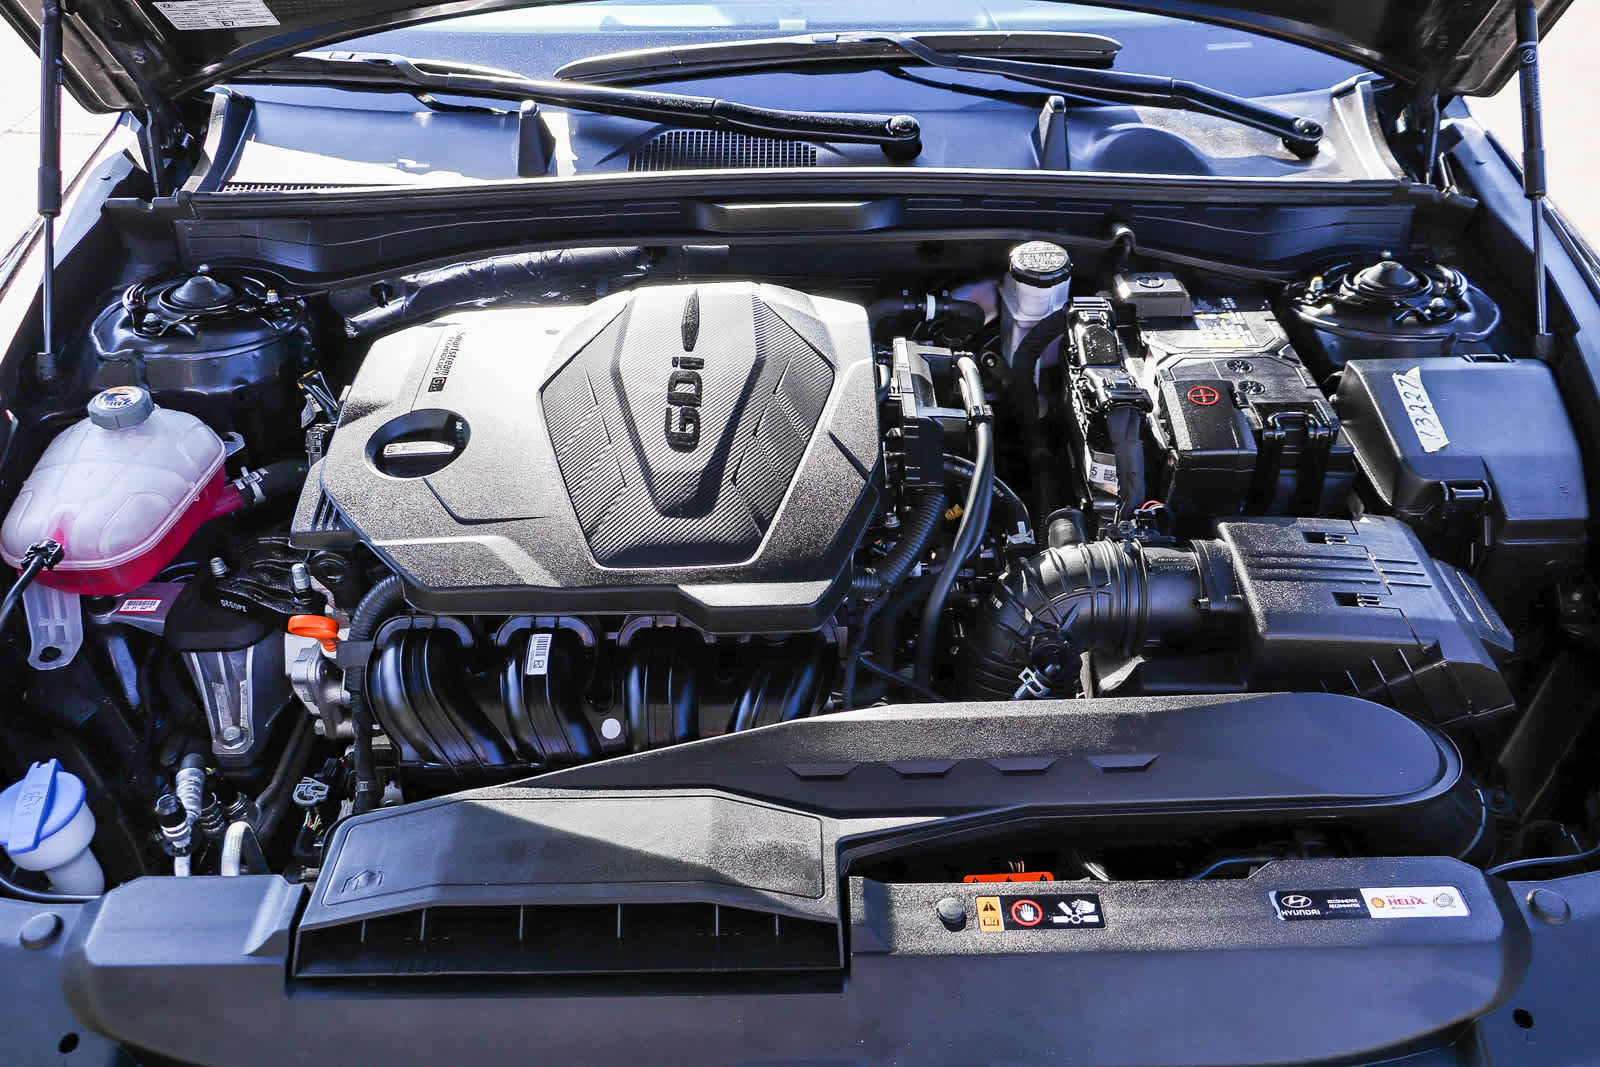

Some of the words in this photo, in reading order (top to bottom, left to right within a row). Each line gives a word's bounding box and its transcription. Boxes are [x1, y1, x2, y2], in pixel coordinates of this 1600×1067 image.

[441, 331, 466, 376] Smartstream
[664, 356, 705, 454] GDi
[1398, 378, 1441, 440] 13227
[1280, 908, 1321, 917] HYUNDAI
[1386, 897, 1425, 906] HELIX
